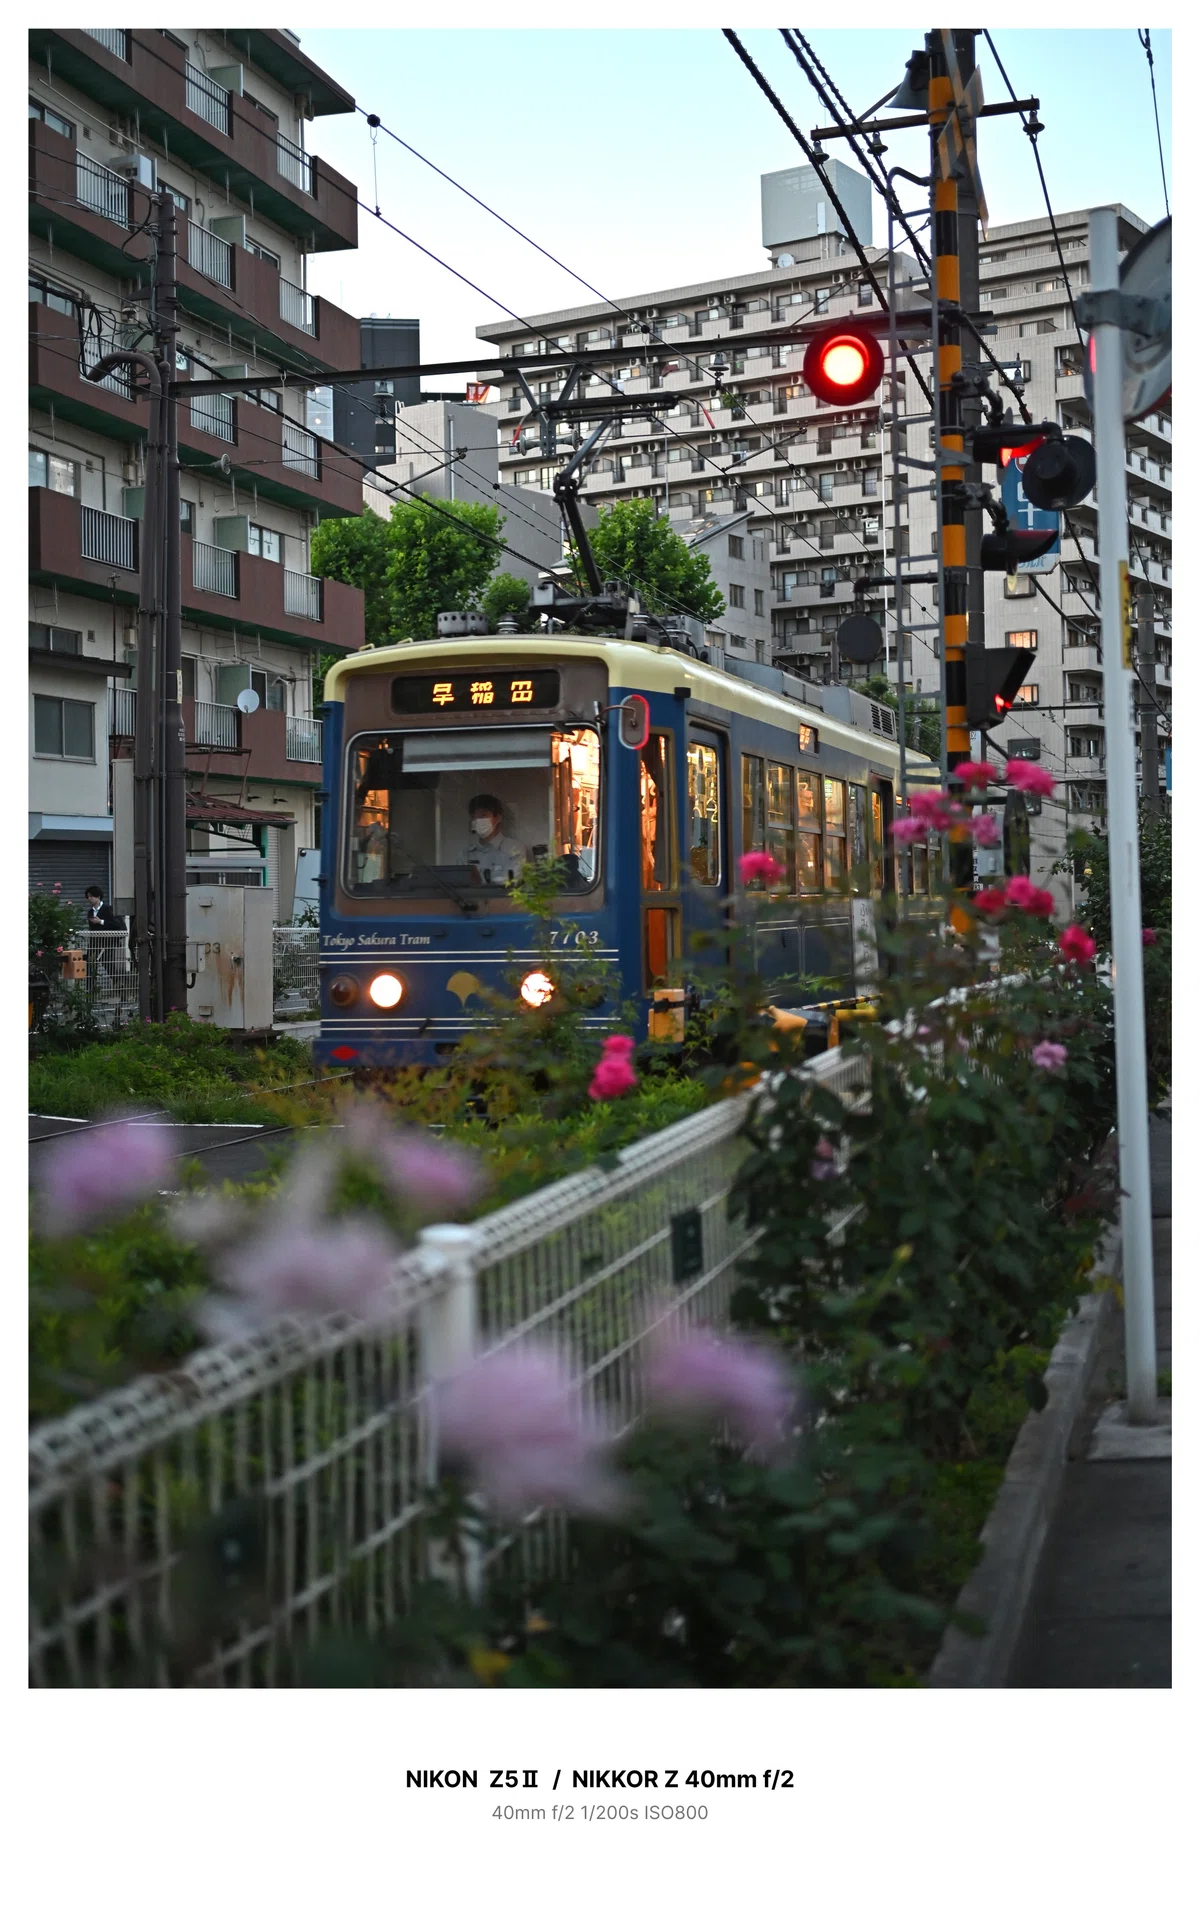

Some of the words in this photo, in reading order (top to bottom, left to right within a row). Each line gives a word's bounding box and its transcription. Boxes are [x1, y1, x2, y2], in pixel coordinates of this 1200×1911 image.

[432, 680, 533, 706] 早稲田
[323, 933, 355, 951] Tokyo
[357, 932, 396, 946] Sakura
[400, 933, 430, 945] Tram
